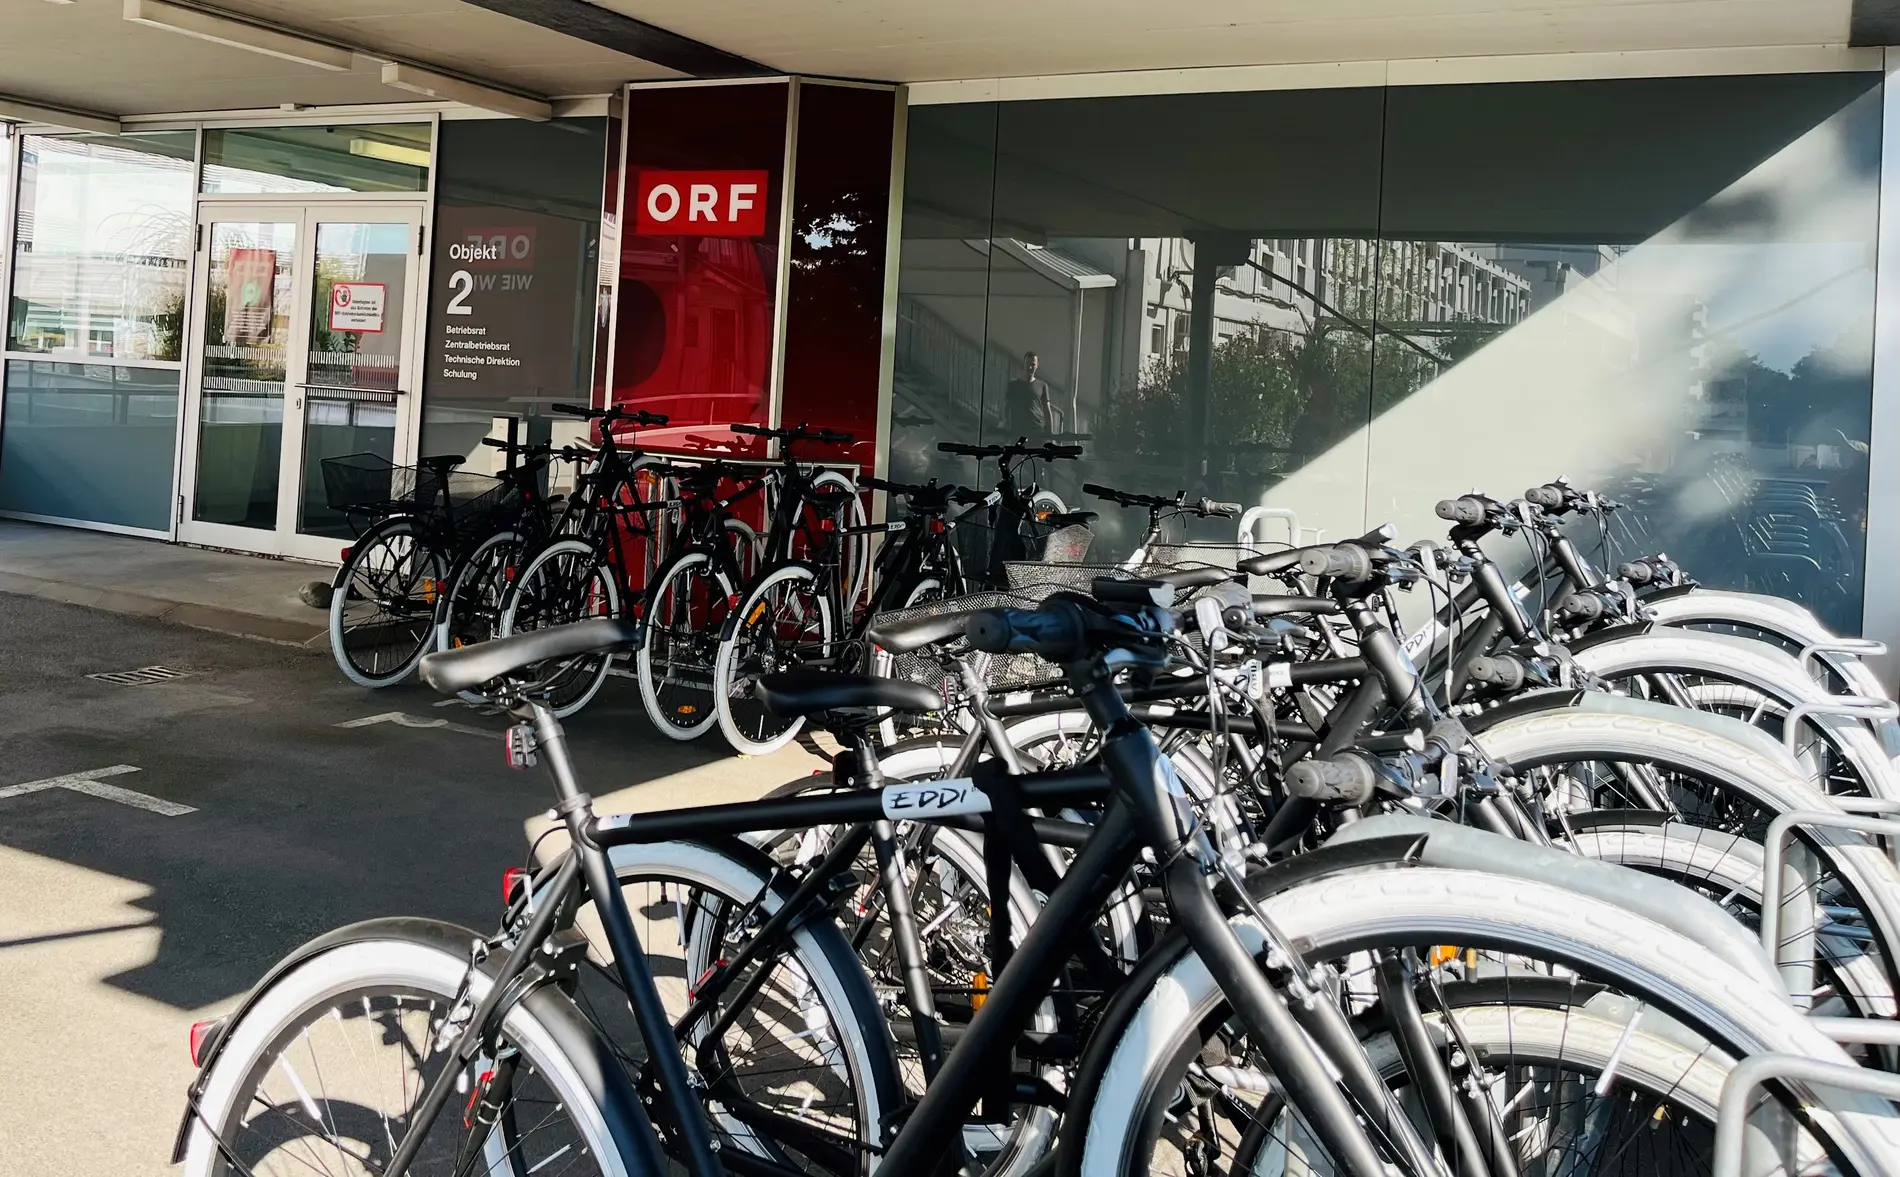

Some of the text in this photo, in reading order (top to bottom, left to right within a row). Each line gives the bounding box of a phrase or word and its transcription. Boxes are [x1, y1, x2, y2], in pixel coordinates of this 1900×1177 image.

[646, 184, 758, 222] ORF
[449, 244, 497, 263] Objekt
[447, 270, 474, 315] 2
[446, 325, 486, 336] Betriebsrat
[445, 339, 511, 351] Zentralbetriebsrat
[444, 354, 521, 367] Technische Direktion
[443, 368, 478, 381] Schulung
[889, 788, 967, 809] EDDI
